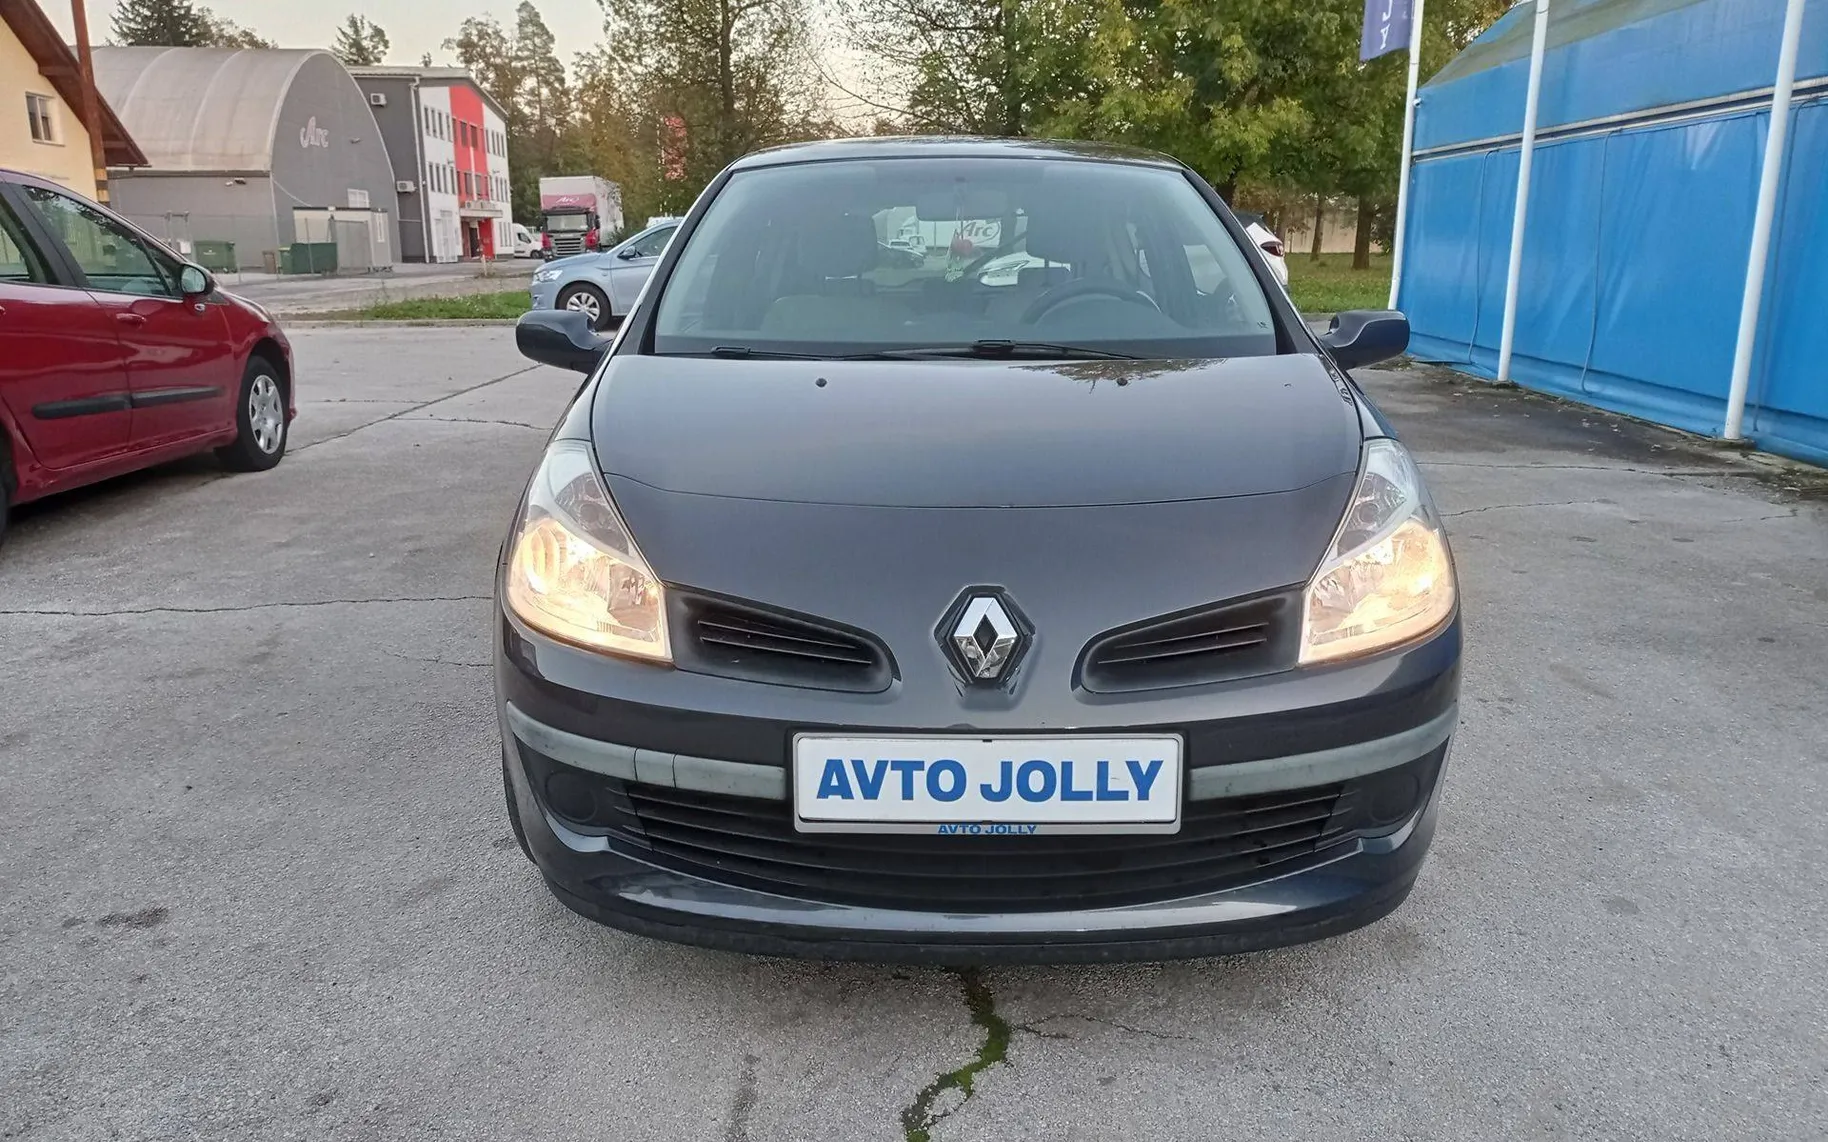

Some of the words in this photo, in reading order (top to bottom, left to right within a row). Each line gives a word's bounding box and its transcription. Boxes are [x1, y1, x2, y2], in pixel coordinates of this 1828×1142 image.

[963, 221, 995, 238] Arc
[816, 759, 967, 802] AVTO
[980, 760, 1164, 802] JOLLY
[938, 824, 982, 834] AVTO
[985, 824, 1037, 834] JOLLY
